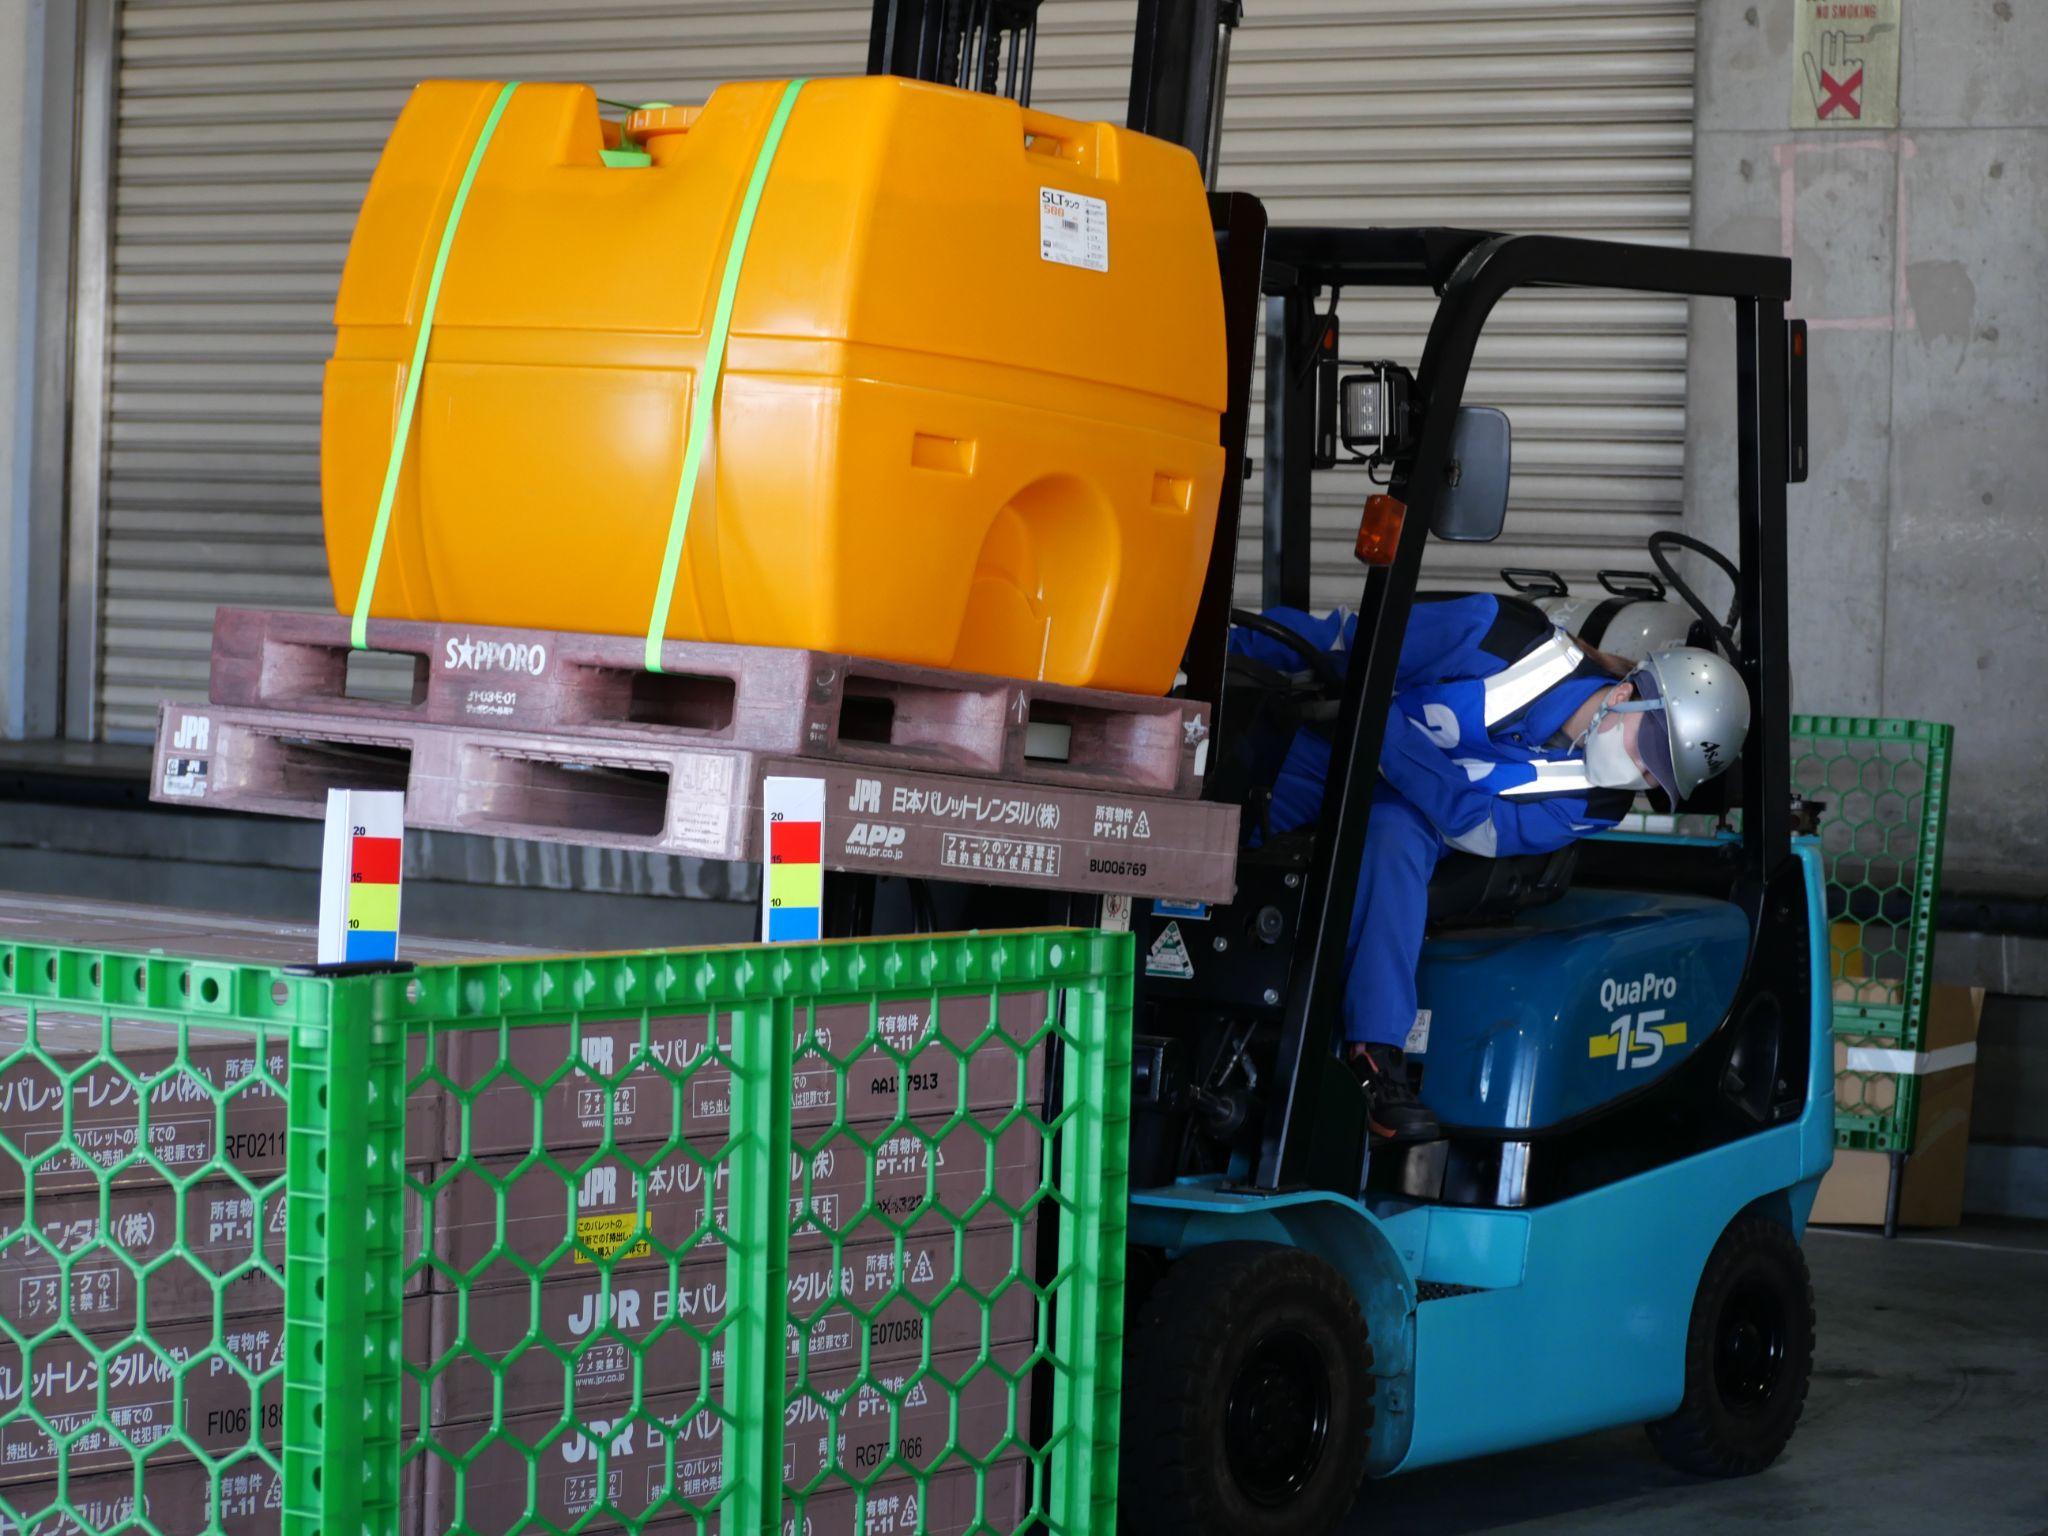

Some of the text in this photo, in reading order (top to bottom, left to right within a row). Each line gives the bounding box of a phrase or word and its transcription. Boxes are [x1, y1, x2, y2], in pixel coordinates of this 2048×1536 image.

[1832, 4, 1877, 18] SMOKING
[174, 715, 210, 750] JPR
[848, 779, 882, 813] JPR
[771, 812, 784, 821] 20
[892, 787, 1060, 830] 日本パレットレンタル(株)
[1095, 805, 1134, 824] 所有物件
[353, 826, 366, 836] 20
[846, 823, 906, 848] APP
[1094, 821, 1128, 839] PT-11
[771, 854, 782, 864] 15
[845, 845, 903, 860] www.jpr.co.jp
[351, 872, 362, 882] 15
[770, 898, 782, 907] 10
[348, 919, 359, 929] 10
[1600, 973, 1677, 1012] QuaPro
[1608, 1009, 1666, 1071] 15
[871, 1073, 938, 1094] AA17913
[876, 1156, 916, 1177] PT-11
[578, 1166, 616, 1207] JPR
[28, 1273, 111, 1298] フォクの
[222, 1331, 270, 1353] 有物件
